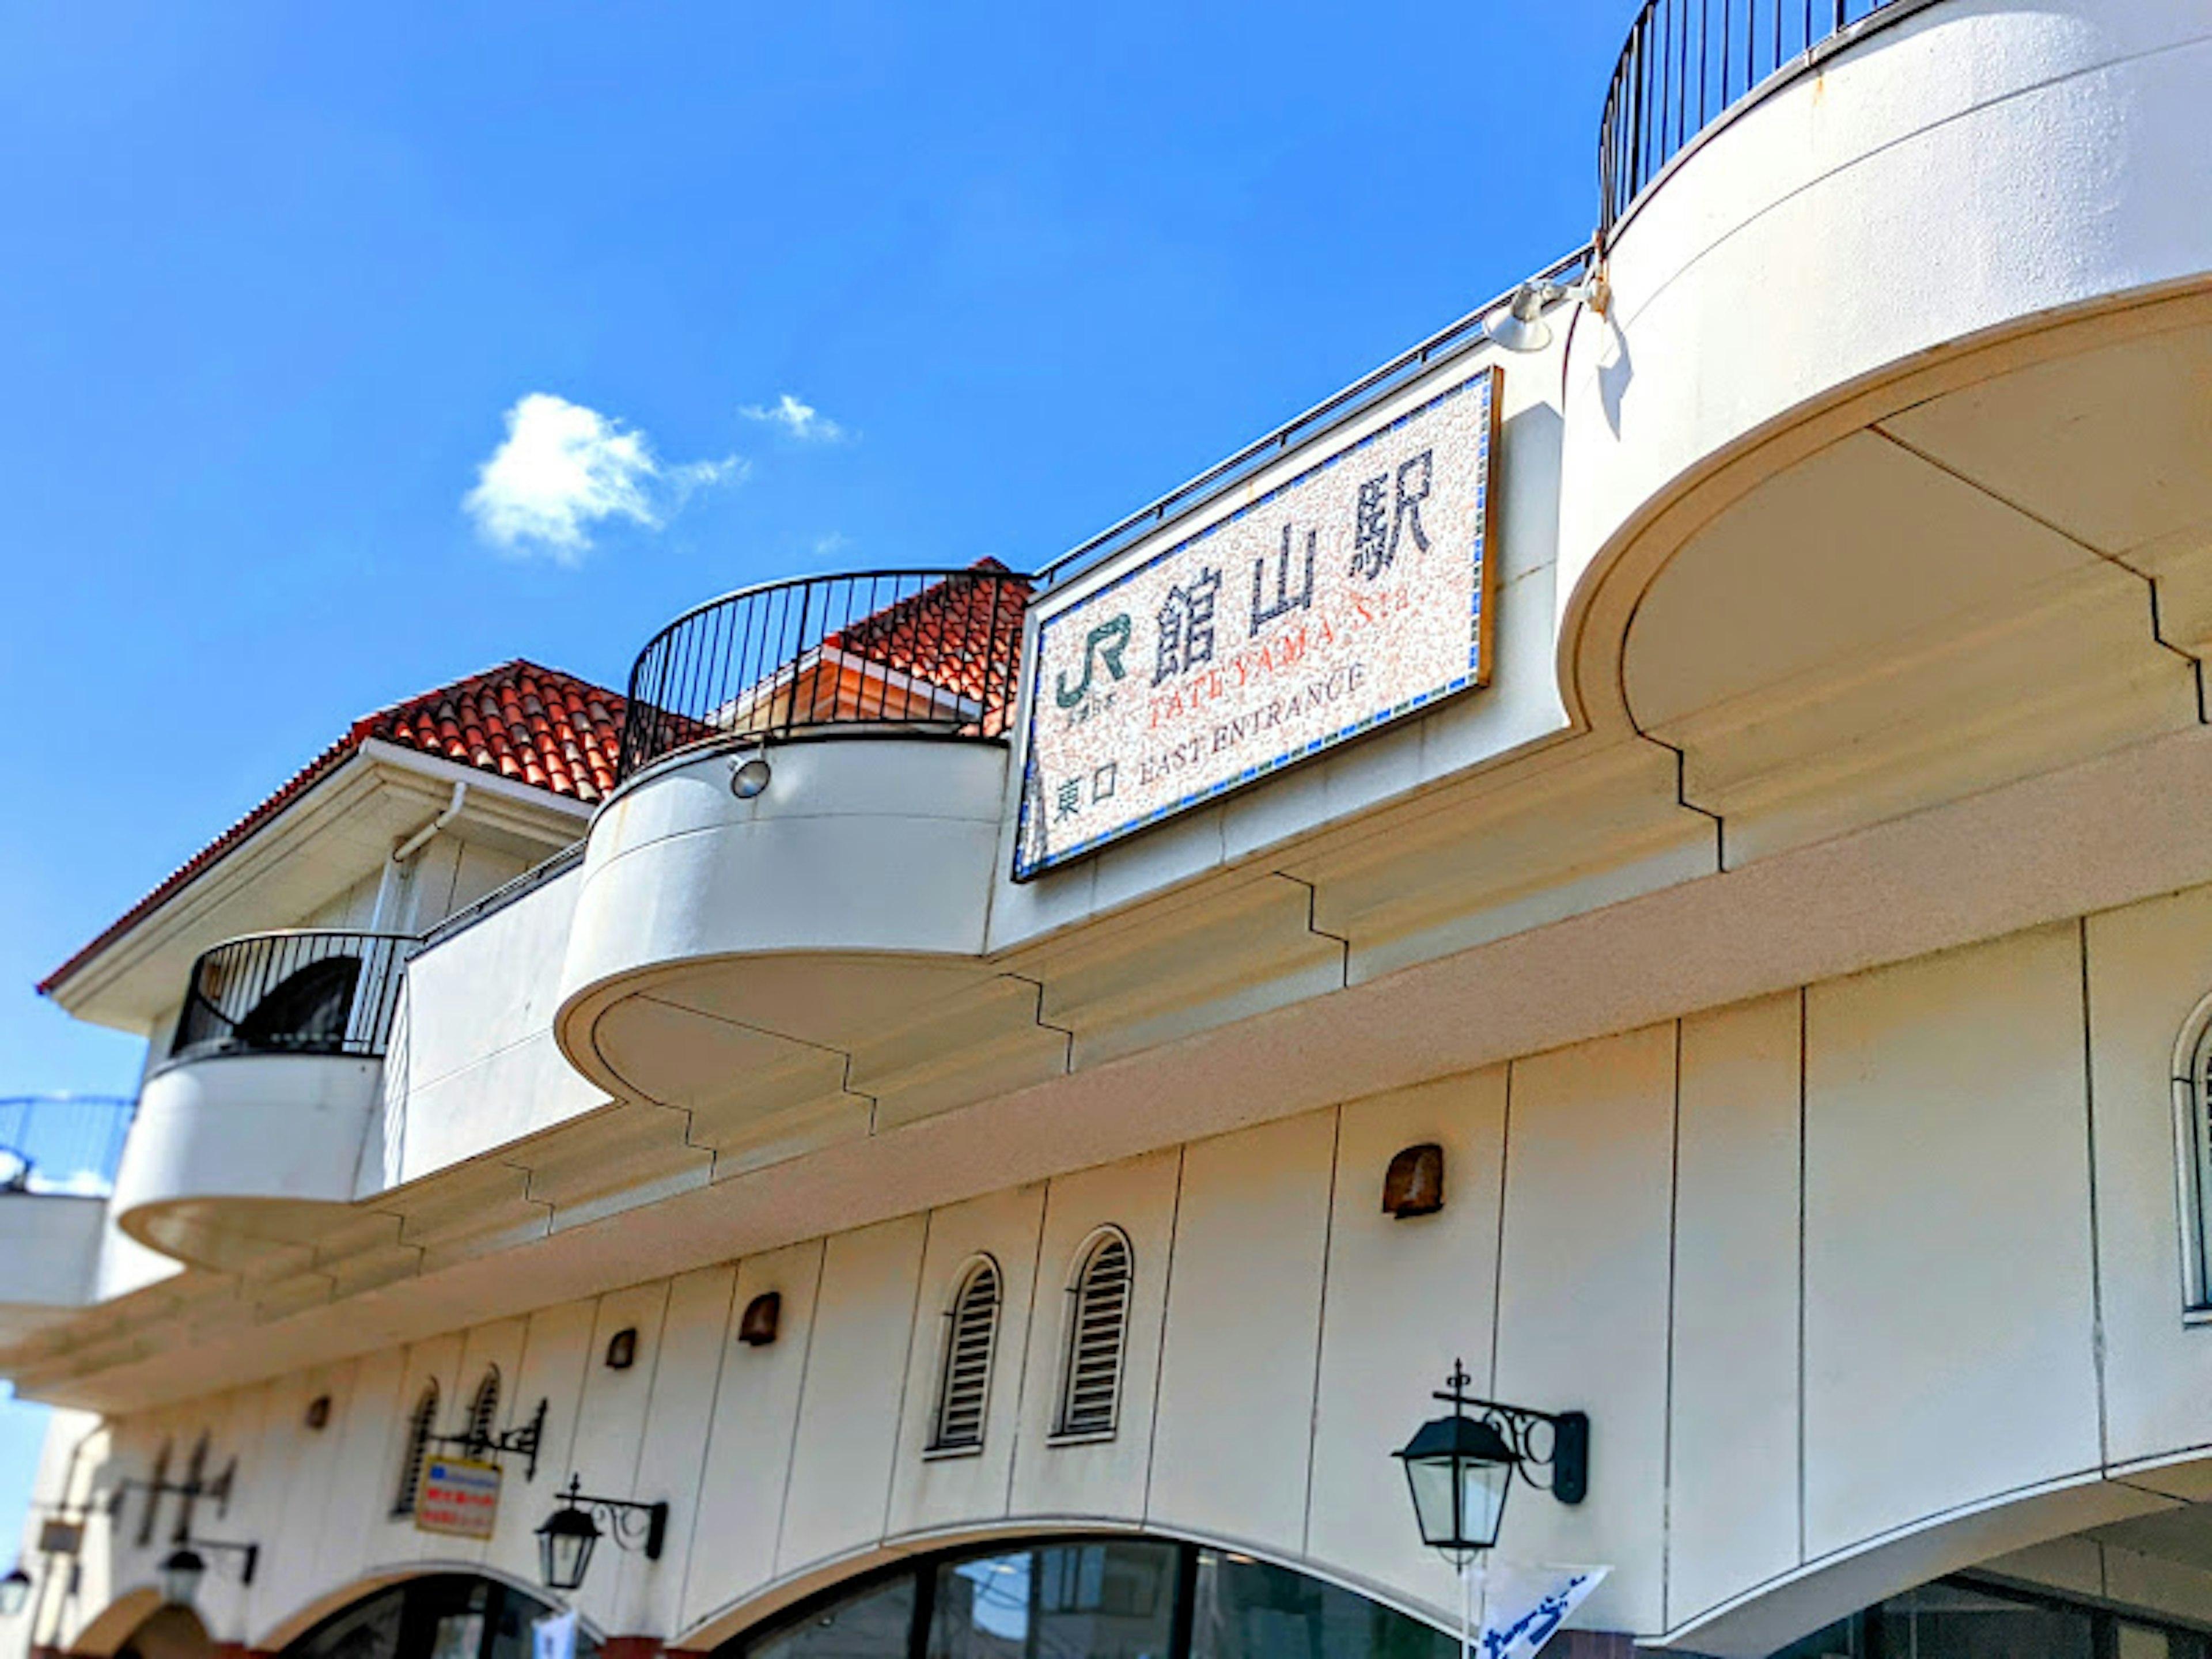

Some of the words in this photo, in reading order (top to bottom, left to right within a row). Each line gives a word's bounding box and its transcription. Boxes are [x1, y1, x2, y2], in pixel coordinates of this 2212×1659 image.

[1150, 448, 1433, 688] 館山駅
[1056, 613, 1131, 708] JR
[1147, 619, 1335, 728] TATEYAMA
[1139, 737, 1199, 785] EAST
[1211, 662, 1365, 754] ENTRANCE
[1054, 762, 1117, 824] 東口
